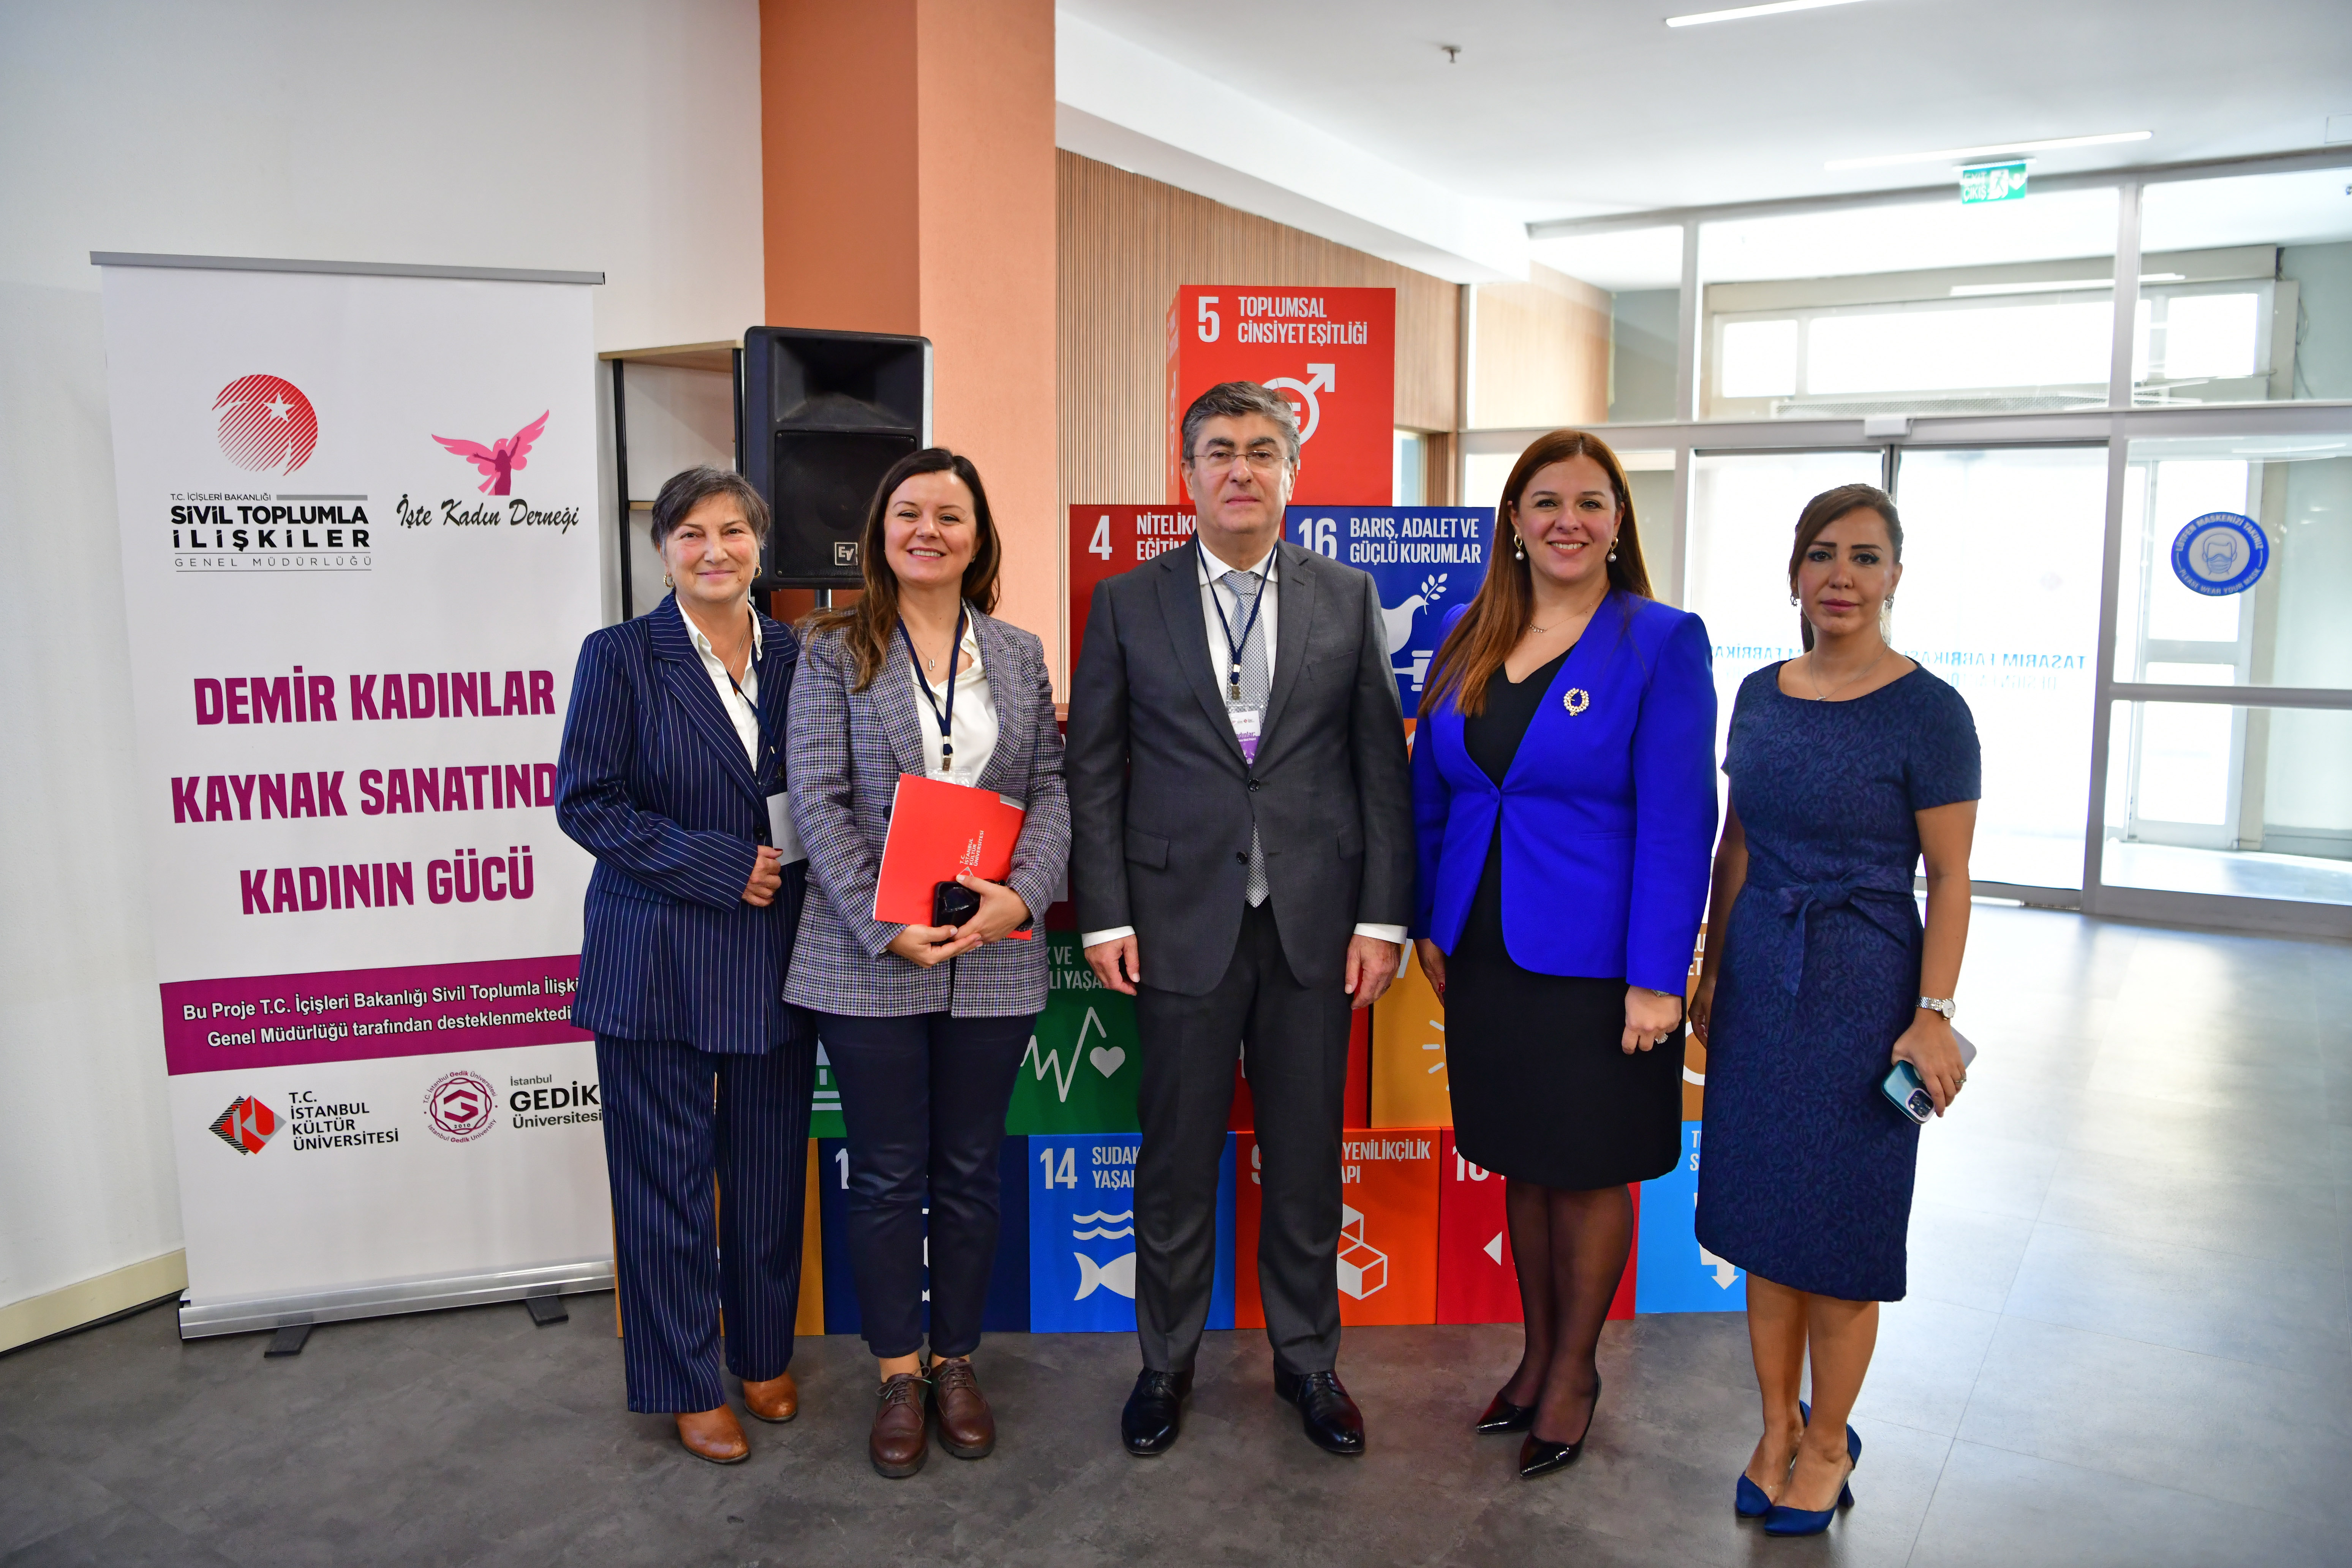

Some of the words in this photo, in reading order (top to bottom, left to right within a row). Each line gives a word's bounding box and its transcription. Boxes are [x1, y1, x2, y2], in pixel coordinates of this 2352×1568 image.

[1238, 297, 1327, 318] TOPLUMSAL
[1198, 296, 1220, 343] 5
[1238, 320, 1306, 343] CİNSİYET
[1308, 321, 1367, 346] EŞİTLİĞİ
[187, 492, 222, 501] İÇİŞLERİ
[224, 493, 271, 501] BAKANLIĞI
[171, 505, 233, 524] SİVİL
[237, 506, 369, 524] TOPLUMLA
[396, 494, 432, 529] İşte
[441, 498, 501, 526] Kadın
[509, 498, 579, 535] Derneği
[1089, 515, 1113, 561] 4
[1298, 518, 1337, 560] 16
[1350, 517, 1399, 540] BARIŞ,
[1401, 518, 1458, 538] ADALET
[1460, 518, 1479, 538] VE
[173, 530, 370, 552] İLİŞKİLER
[175, 558, 237, 567] GENEL
[253, 555, 371, 566] MÜDÜRLÜĞÜ
[838, 546, 855, 561] EV
[1350, 541, 1397, 566] GÜÇLÜ
[1400, 543, 1481, 563] KURUMLAR
[193, 665, 337, 726] DEMİR
[350, 670, 556, 721] KADINLAR
[171, 771, 348, 824] KAYNAK
[360, 763, 558, 816] SANATIND
[240, 861, 414, 915] KADININ
[427, 846, 534, 905] GÜCÜ
[1054, 946, 1073, 965] VE
[1064, 970, 1105, 991] YAŞA
[183, 1005, 207, 1020] Bu
[212, 1001, 256, 1020] Proje
[259, 998, 291, 1015] T.C.
[295, 993, 349, 1015] İçişleri
[354, 988, 428, 1008] Bakanlığı
[432, 985, 466, 1003] Sivil
[469, 981, 541, 1002] Toplumla
[544, 976, 579, 996] İlişki
[207, 1029, 256, 1047] Genel
[261, 1022, 348, 1043] Müdürlüğü
[352, 1017, 433, 1037] tarafından
[437, 1005, 571, 1030] desteklenmektedi
[470, 1071, 498, 1097] Üniversitesi
[510, 1074, 552, 1086] İstanbul
[288, 1091, 318, 1104] T.C.
[510, 1081, 600, 1112] GEDİK
[290, 1102, 370, 1120] İSTANBUL
[513, 1109, 602, 1129] Üniversitesi
[292, 1117, 356, 1135] KÜLTÜR
[471, 1119, 497, 1140] University
[293, 1128, 400, 1151] ÜNİVERSİTESİ
[1342, 1138, 1431, 1162] YENİLİKÇİLİK
[1092, 1146, 1140, 1165] SUDAK
[1040, 1148, 1078, 1189] 14
